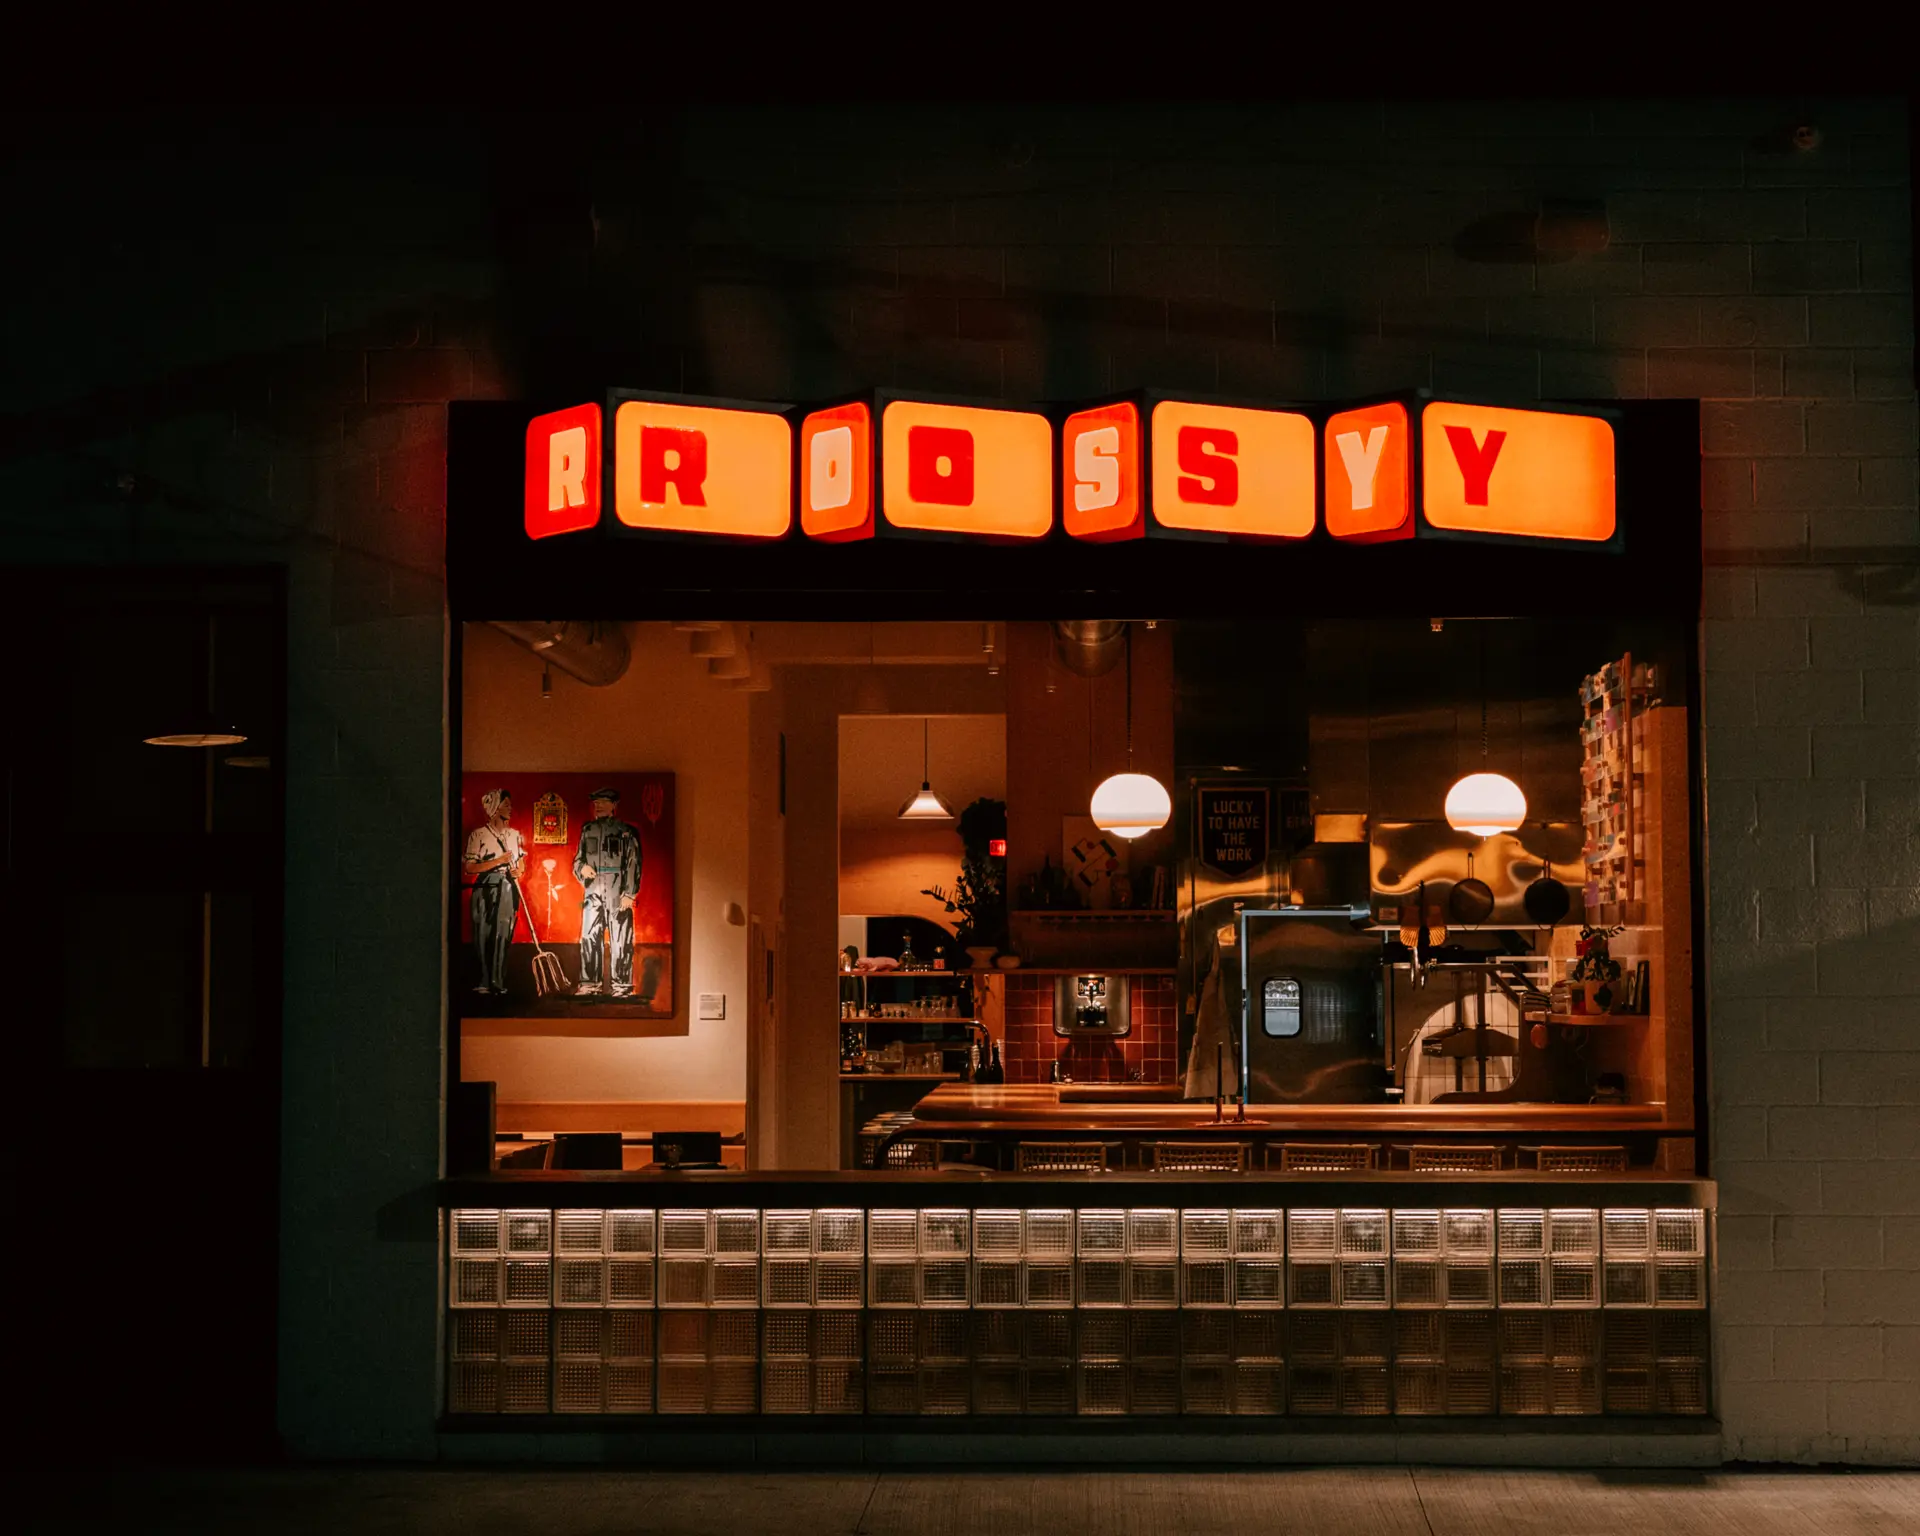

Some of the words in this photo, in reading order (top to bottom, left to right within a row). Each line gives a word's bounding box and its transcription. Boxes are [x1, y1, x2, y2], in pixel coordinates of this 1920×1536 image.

[1212, 800, 1255, 814] LUCKY
[1207, 816, 1224, 830] TO
[1228, 816, 1261, 830] HAVE
[1222, 832, 1247, 846] THE
[1216, 847, 1253, 862] WORK
